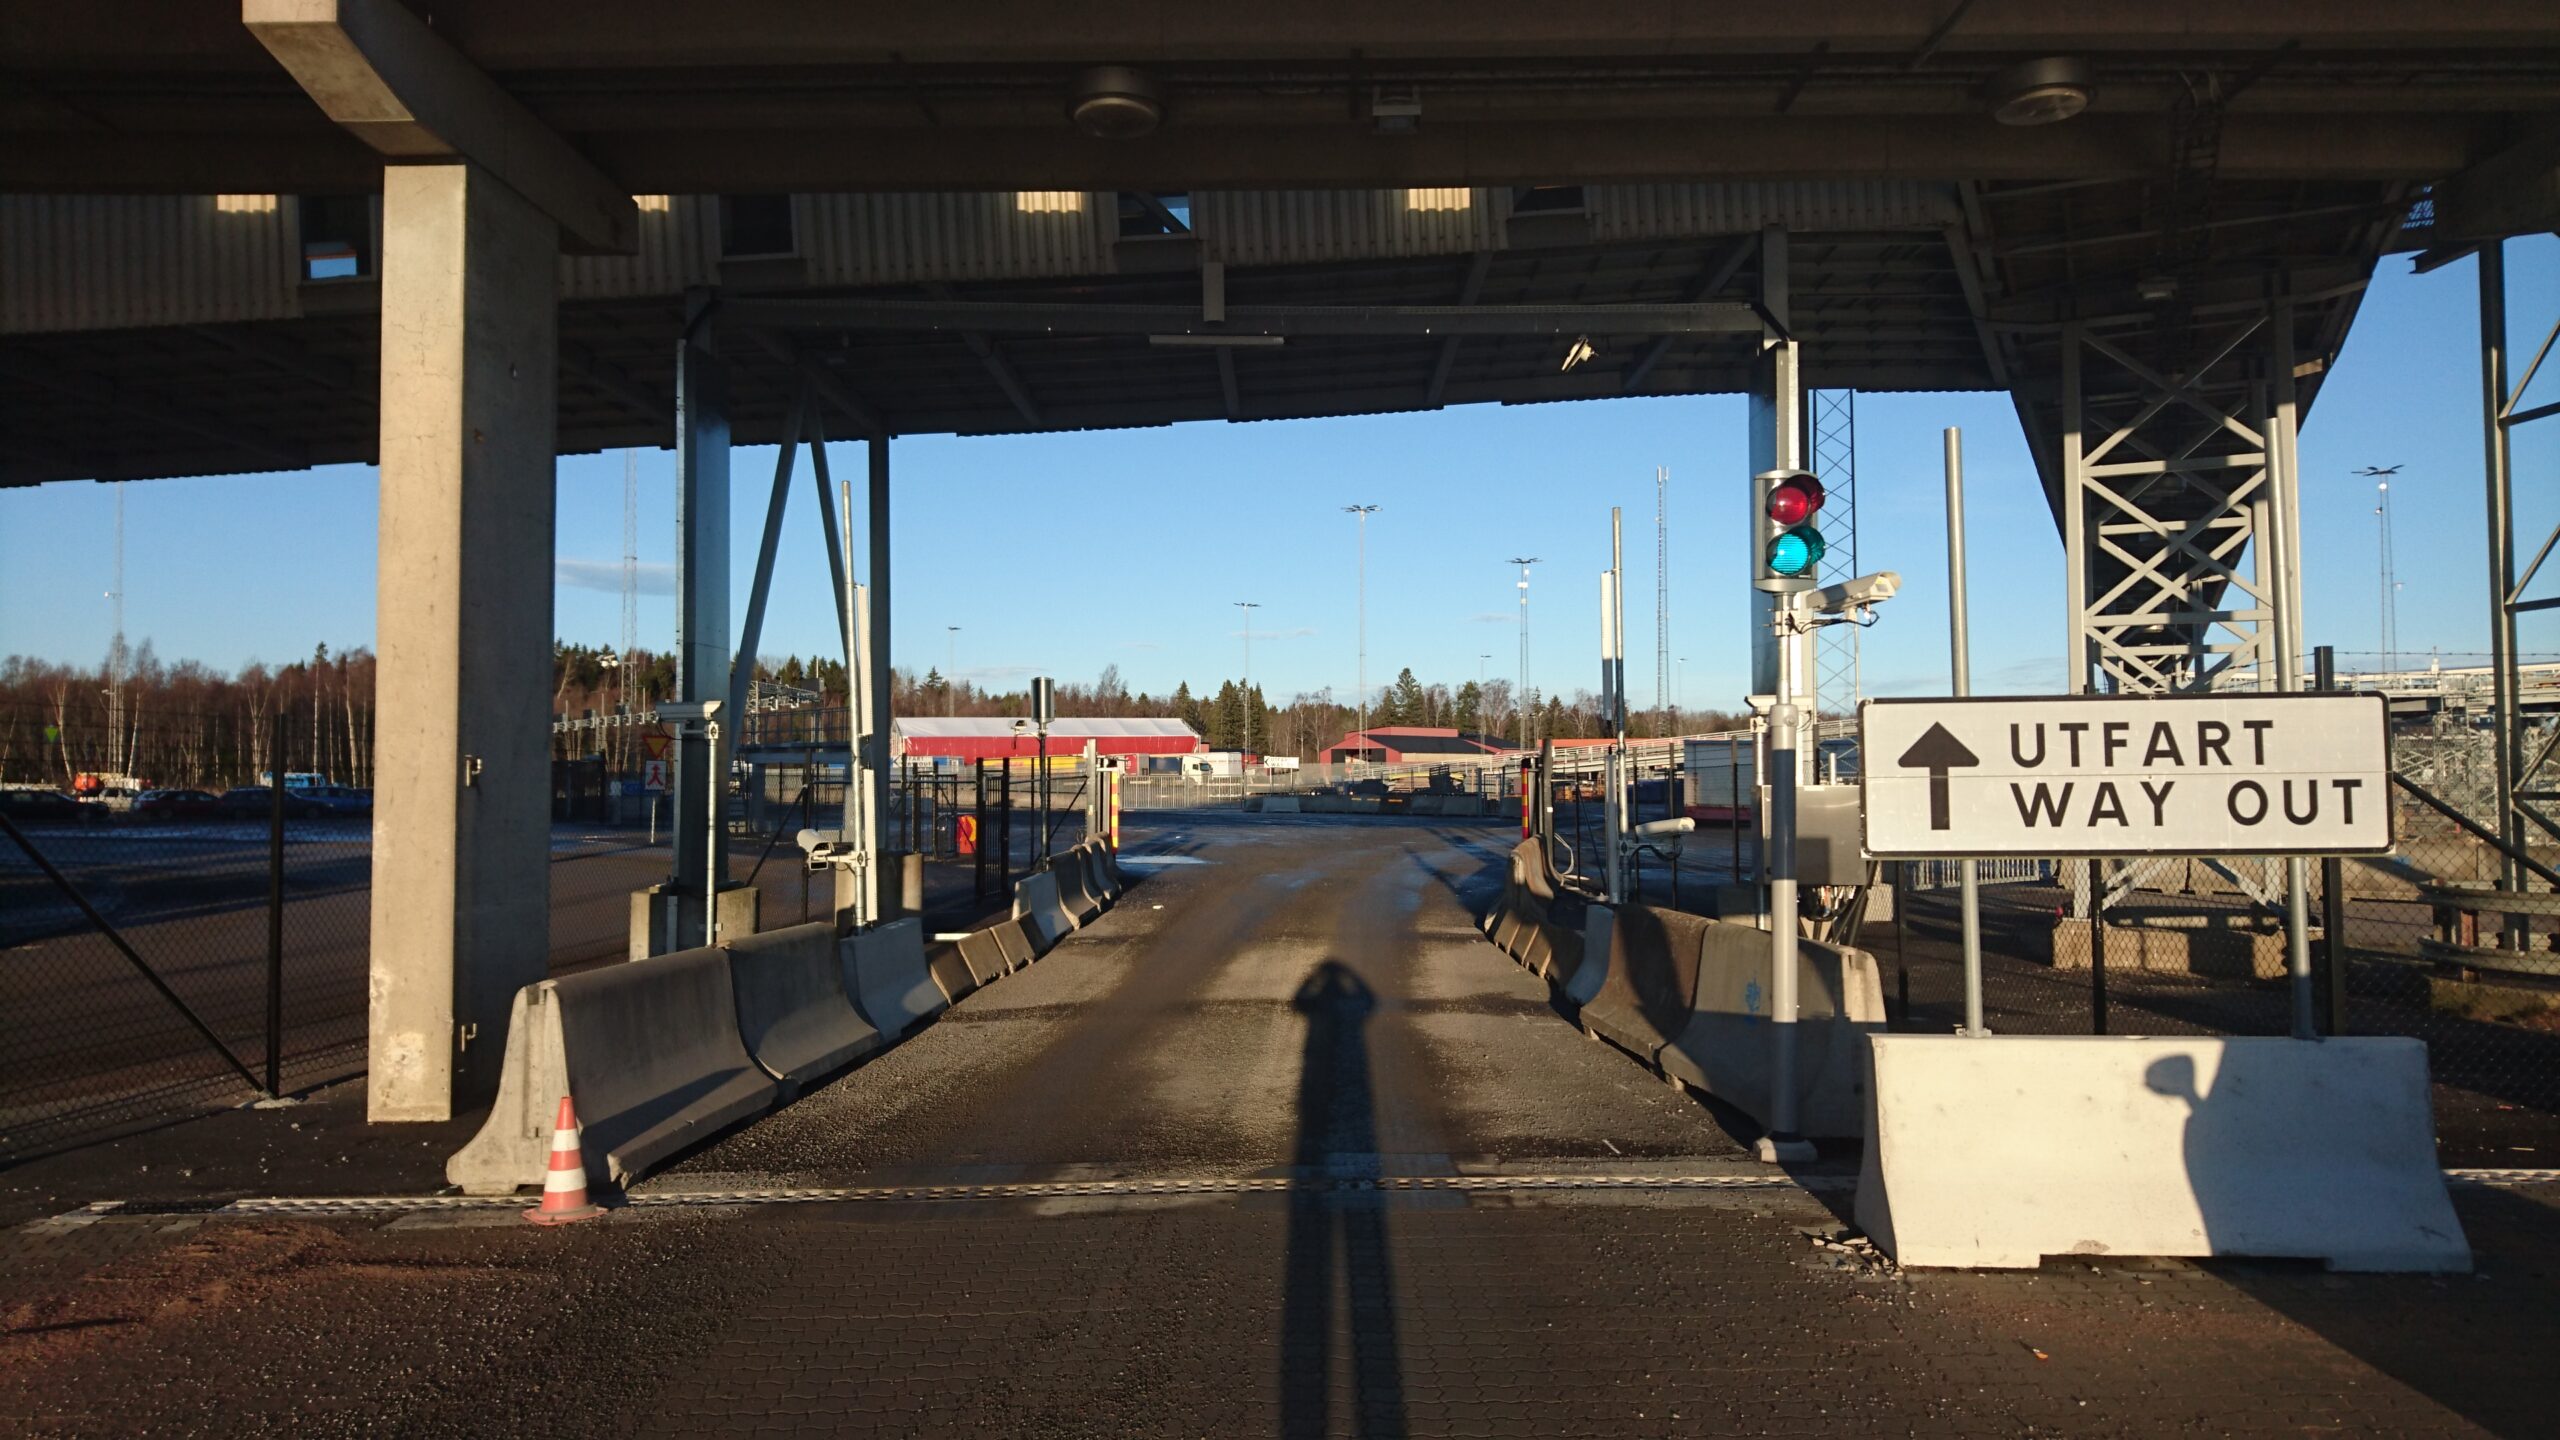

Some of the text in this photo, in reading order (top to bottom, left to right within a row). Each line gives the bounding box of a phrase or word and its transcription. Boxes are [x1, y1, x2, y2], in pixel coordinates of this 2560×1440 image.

[2010, 720, 2273, 768] UTFART
[2010, 778, 2363, 828] WAY OUT
